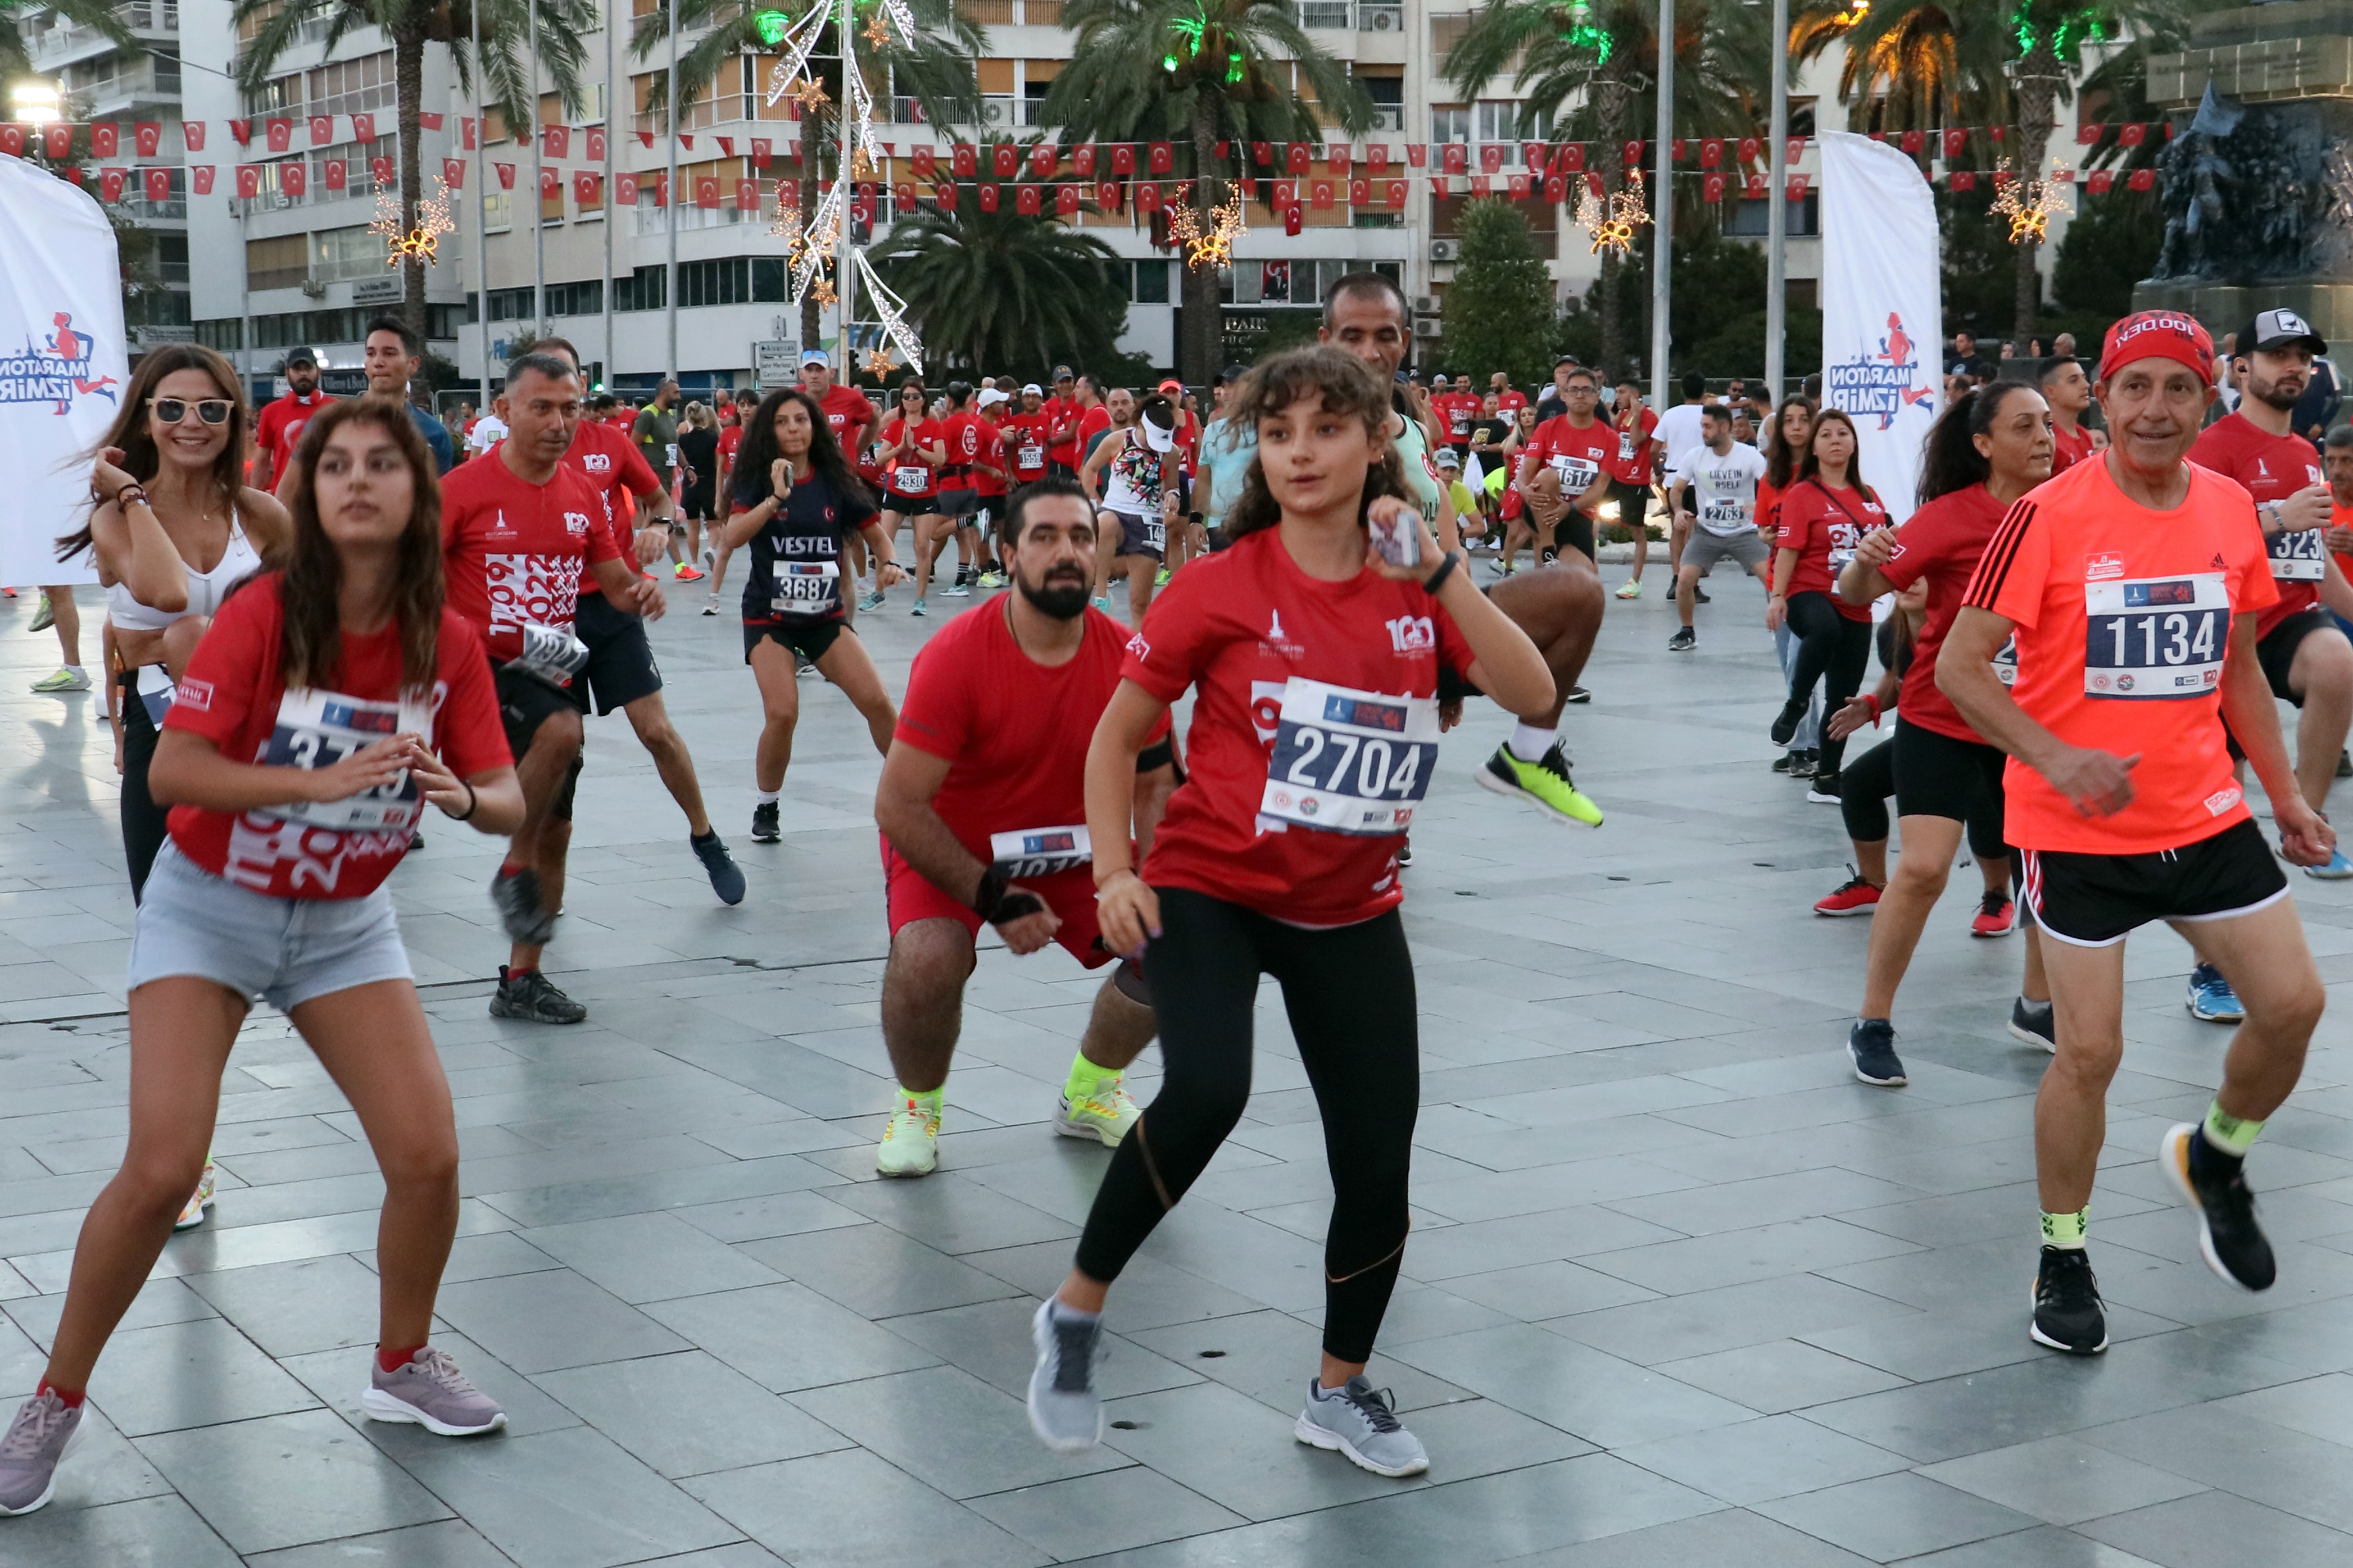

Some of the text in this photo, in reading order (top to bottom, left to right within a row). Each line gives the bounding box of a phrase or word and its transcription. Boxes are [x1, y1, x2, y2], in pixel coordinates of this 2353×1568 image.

[1021, 453, 1041, 463] 1559
[897, 475, 925, 488] 2930
[1709, 506, 1741, 519] 2763
[771, 535, 838, 555] VESTEL
[2275, 527, 2324, 561] 323
[779, 576, 833, 600] 3687
[2106, 611, 2215, 666] 1134
[1286, 726, 1421, 799] 2704
